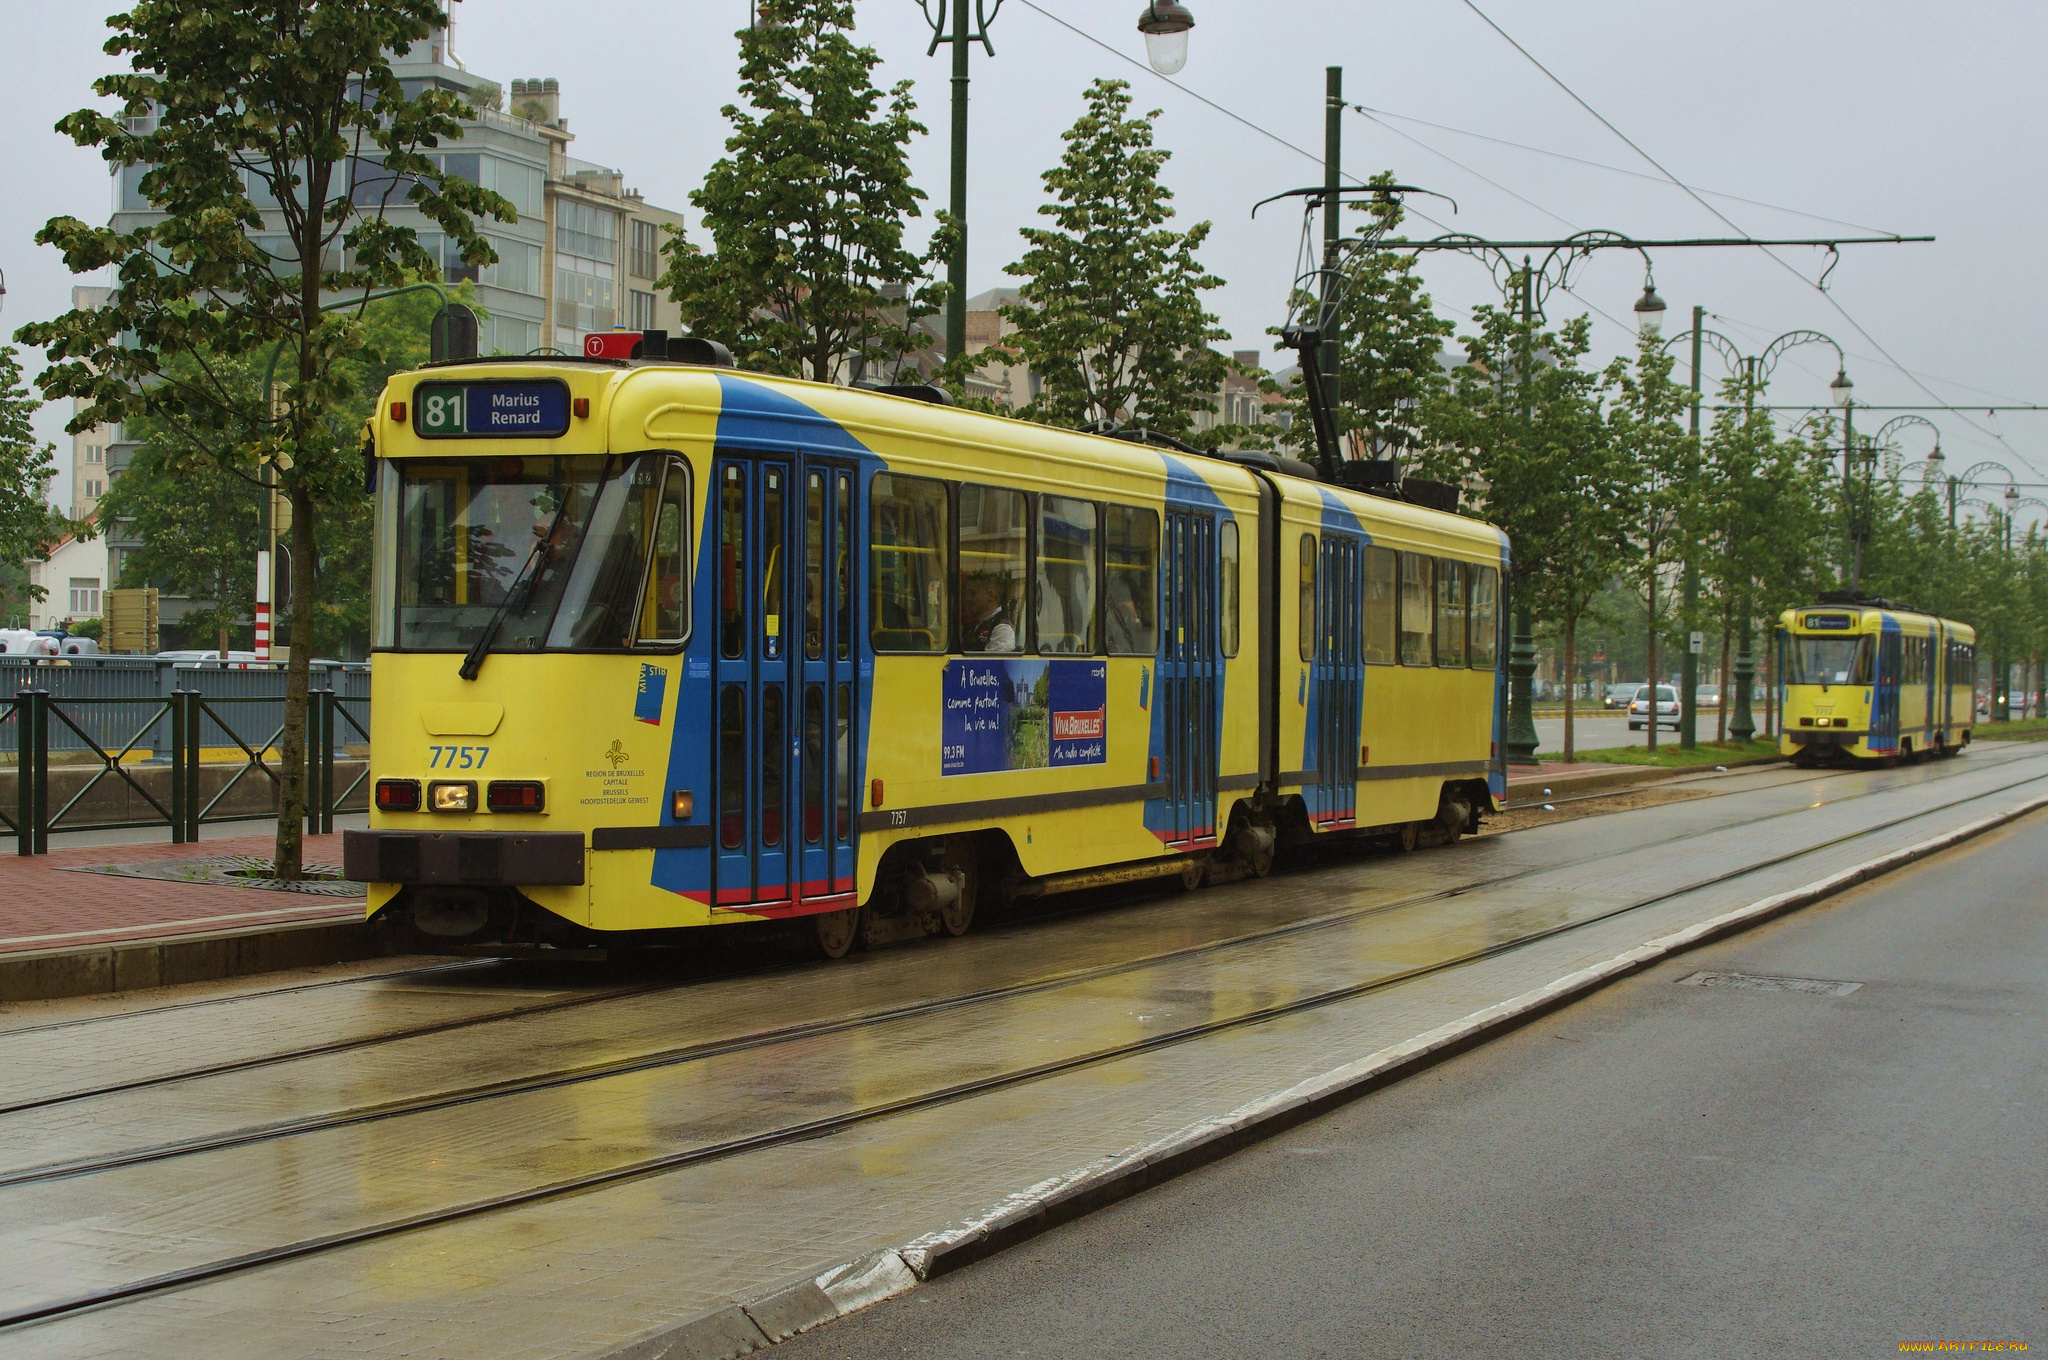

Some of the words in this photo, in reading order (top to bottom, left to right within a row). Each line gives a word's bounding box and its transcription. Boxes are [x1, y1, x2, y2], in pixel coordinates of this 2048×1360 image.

[492, 393, 540, 407] Marius
[426, 395, 461, 427] 81
[491, 410, 541, 425] Renard
[1807, 617, 1819, 627] 81
[639, 664, 647, 693] MIVB
[649, 666, 667, 676] STIB
[960, 665, 967, 689] À
[947, 697, 972, 710] comme
[974, 690, 1000, 714] partout,
[964, 714, 972, 732] la
[974, 717, 986, 731] vie
[988, 713, 1000, 731] va!
[429, 746, 490, 769] 7757
[943, 745, 955, 760] 99.3
[956, 745, 965, 759] FM
[1053, 745, 1064, 759] Ma
[1065, 743, 1078, 759] radio
[891, 810, 907, 825] 7757
